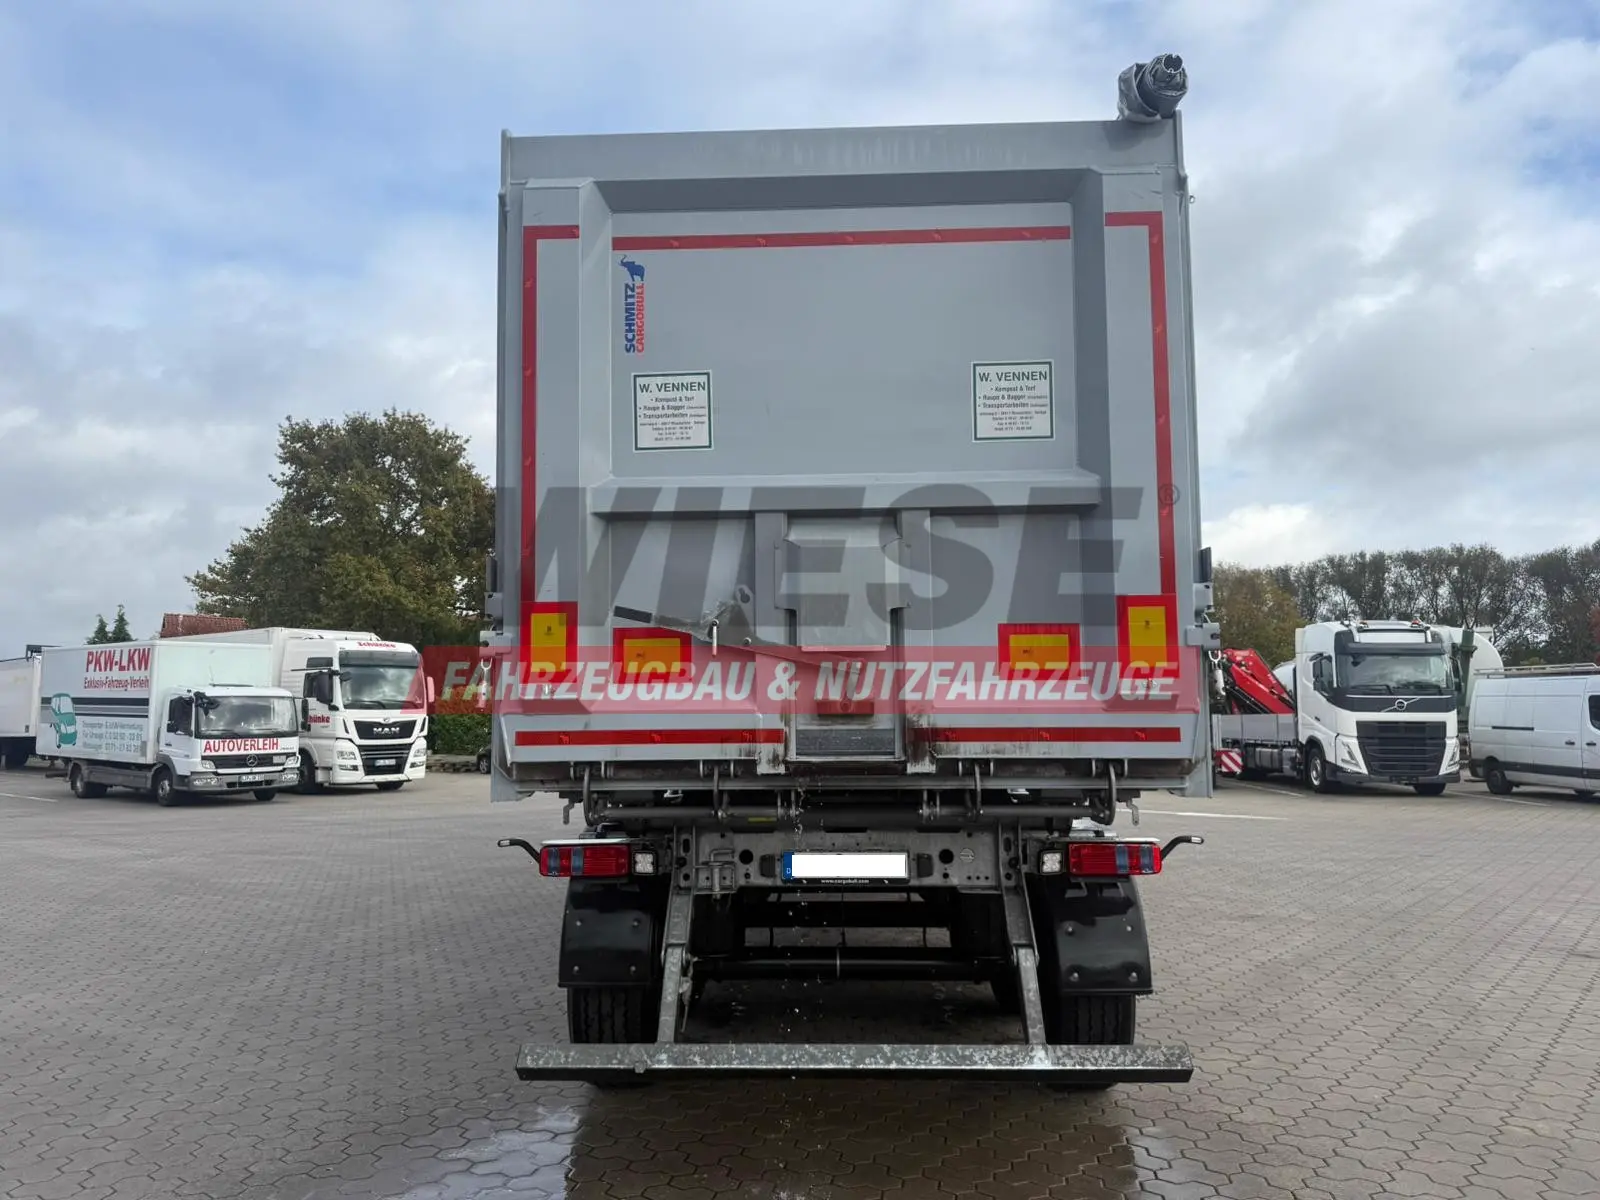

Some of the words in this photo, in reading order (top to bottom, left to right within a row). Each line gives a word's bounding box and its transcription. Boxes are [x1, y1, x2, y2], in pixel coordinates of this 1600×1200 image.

[625, 283, 635, 353] SCHMITZ
[636, 283, 645, 353] CARGOBULL
[978, 372, 992, 382] W.
[996, 370, 1048, 382] VENNEN
[639, 383, 652, 393] W.
[656, 381, 706, 393] VENNEN
[86, 647, 151, 673] PKW-LKW
[203, 738, 279, 753] AUTOVERLEIH
